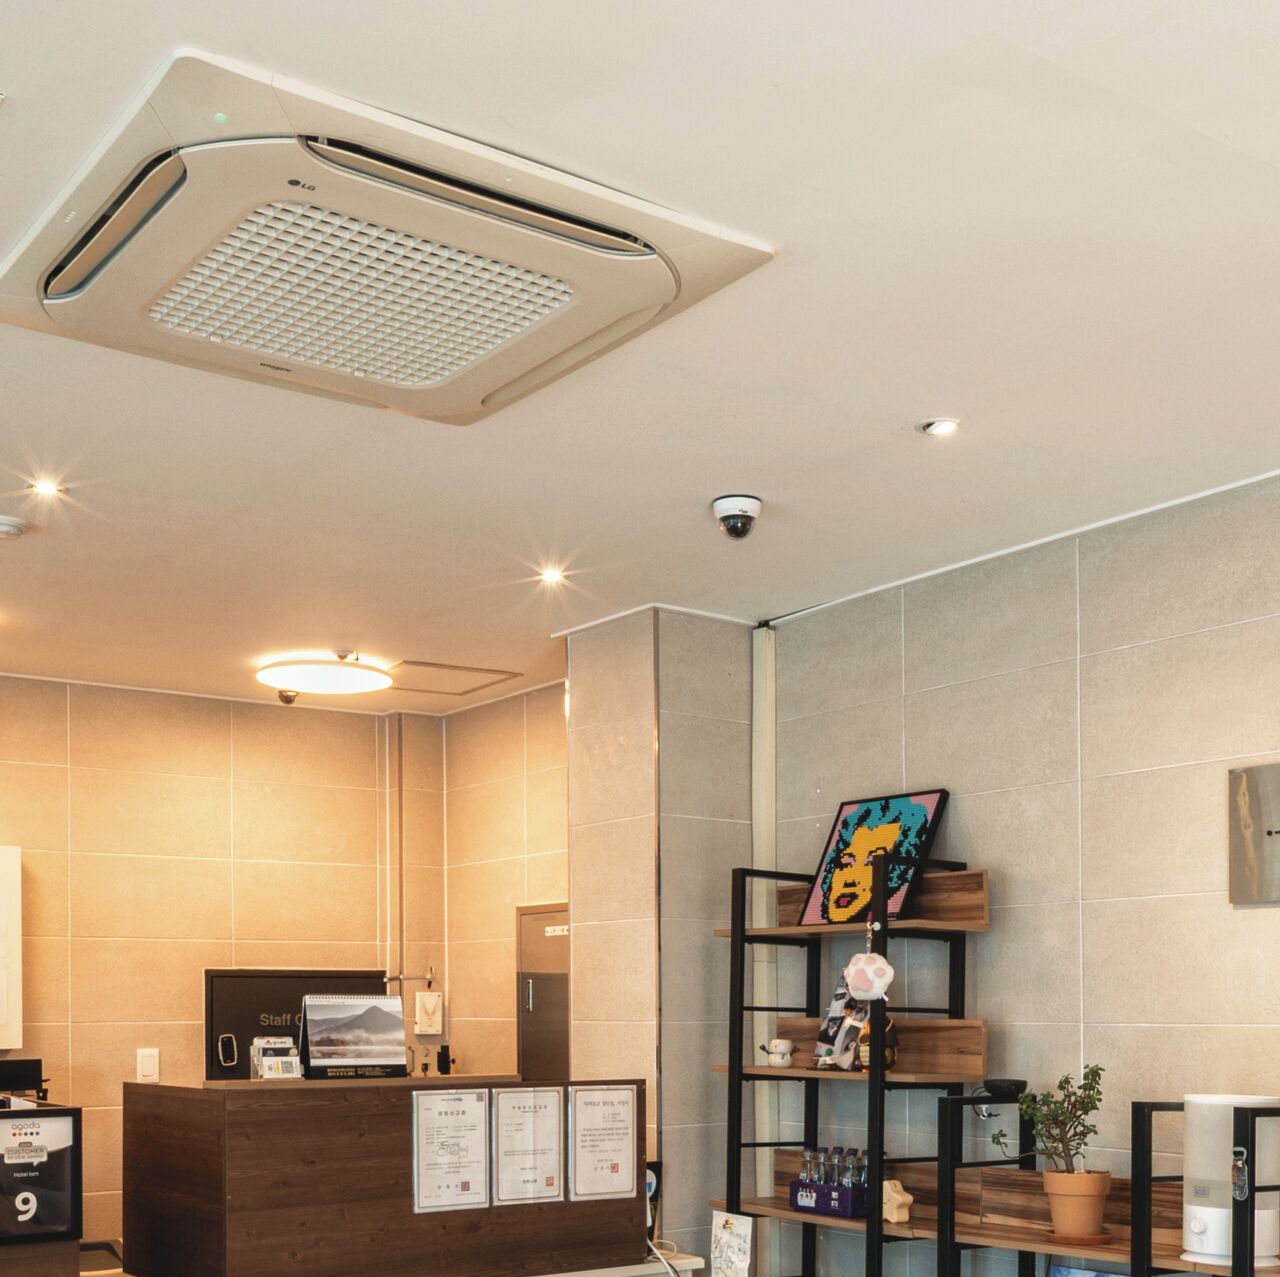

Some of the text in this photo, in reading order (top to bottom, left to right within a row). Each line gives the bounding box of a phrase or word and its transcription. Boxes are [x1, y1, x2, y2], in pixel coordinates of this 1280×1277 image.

[301, 183, 316, 191] LG
[260, 1013, 292, 1026] Staff
[11, 1122, 40, 1132] agoda
[7, 1147, 45, 1155] CUSTOMER
[15, 1191, 38, 1222] 9
